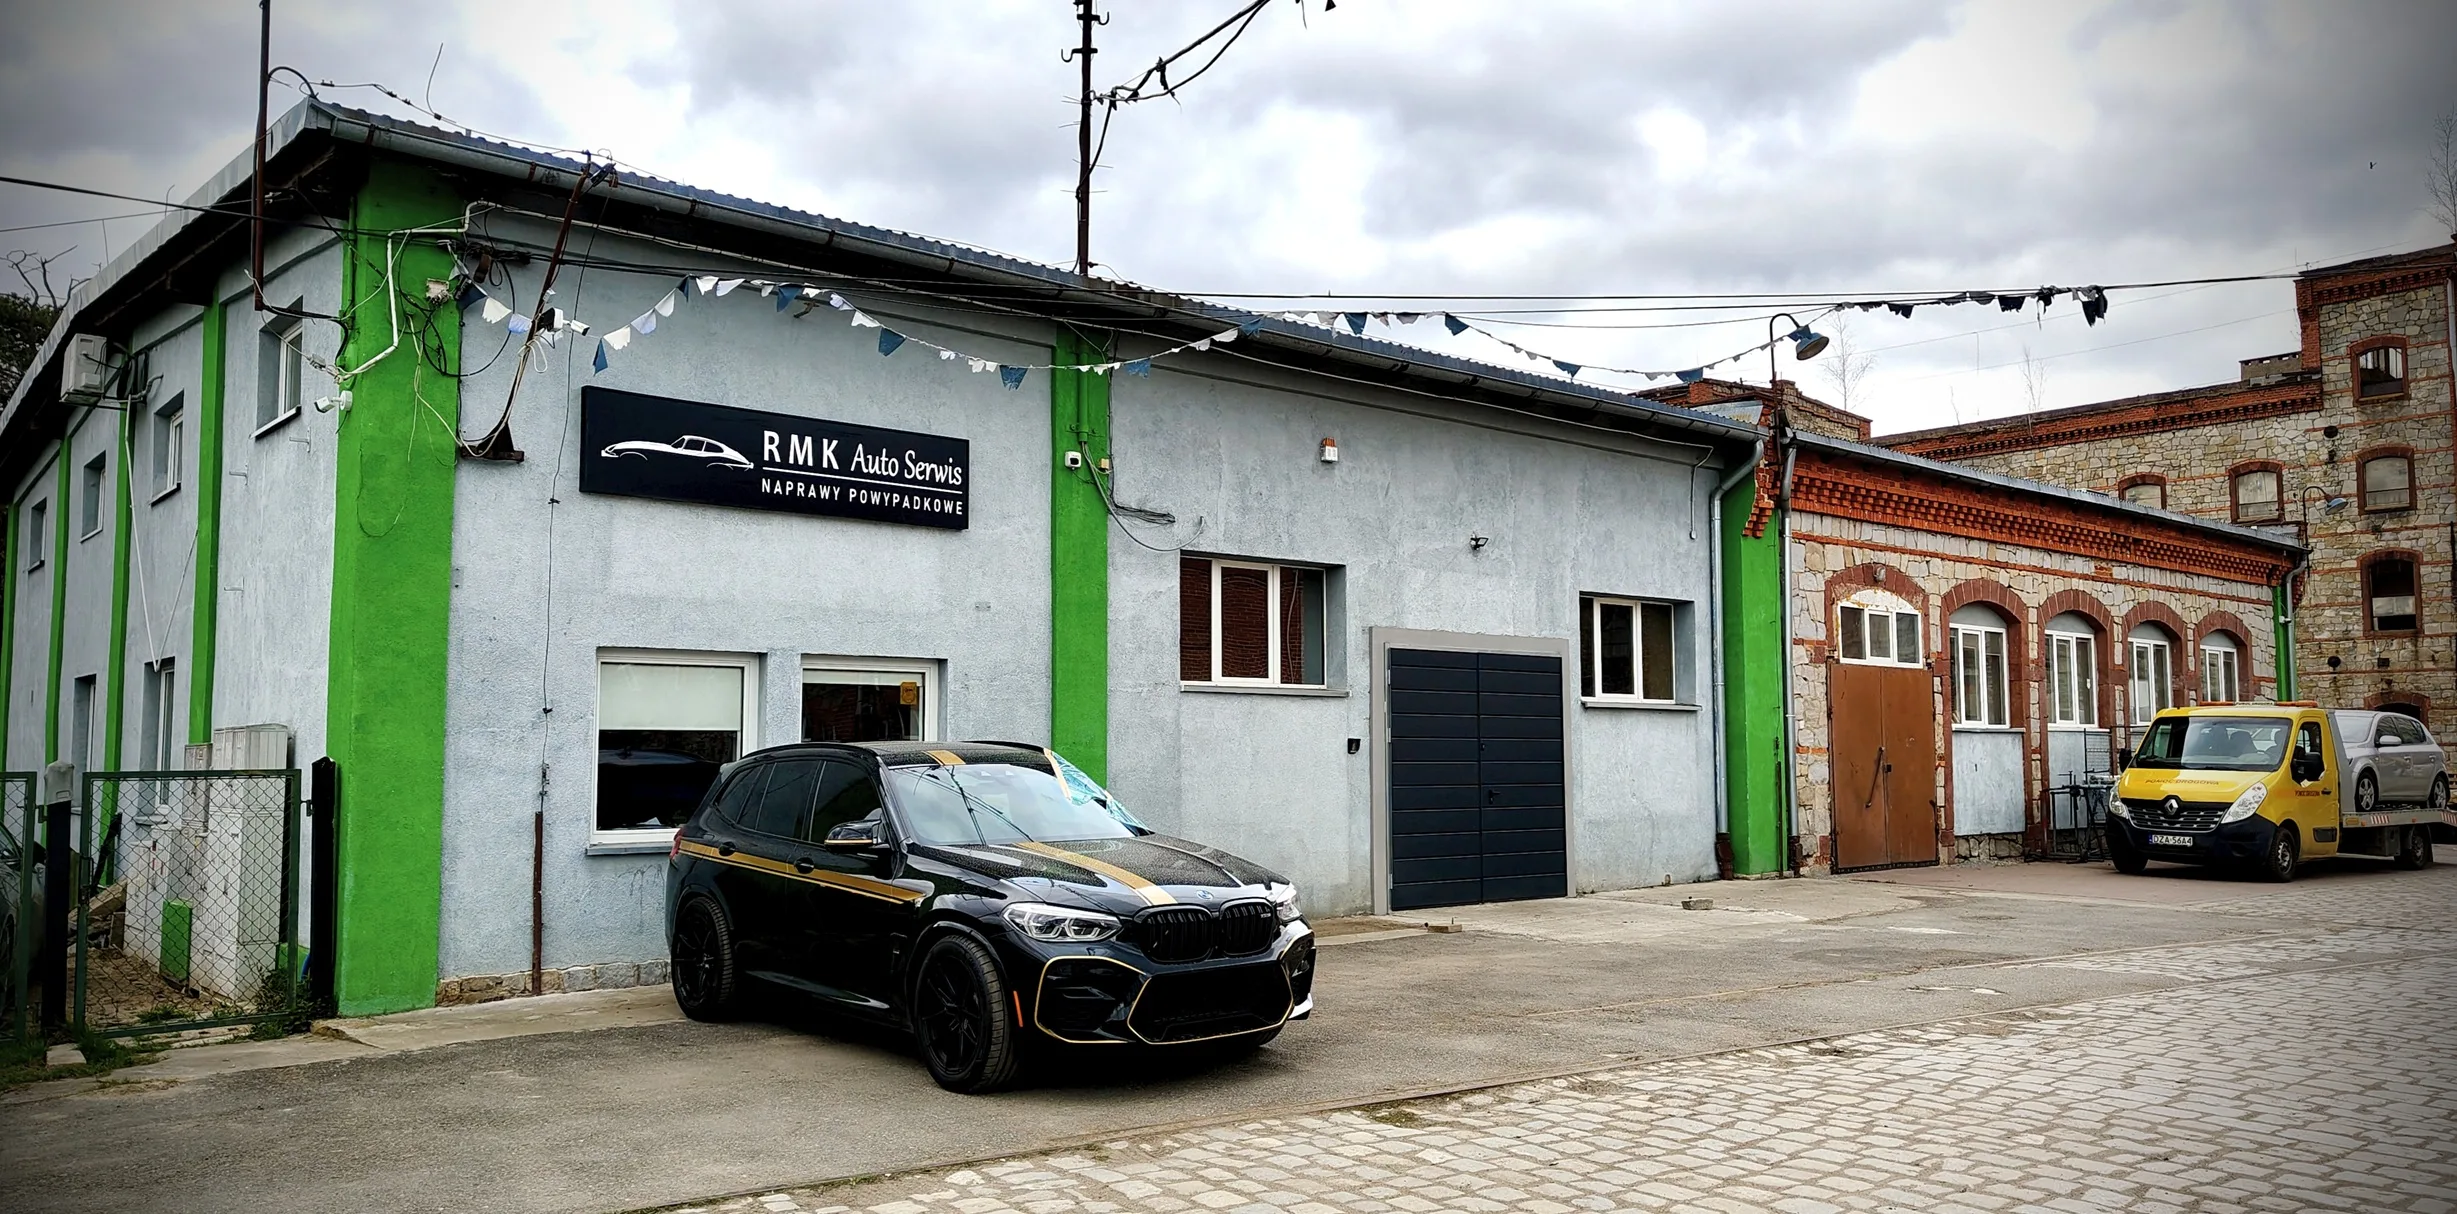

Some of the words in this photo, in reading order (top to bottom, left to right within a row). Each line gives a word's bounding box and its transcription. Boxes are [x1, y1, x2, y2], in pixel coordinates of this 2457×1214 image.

[763, 430, 840, 470] RMK
[850, 443, 899, 477] Auto
[904, 449, 963, 486] Serwis
[761, 477, 841, 501] NAPRAWY
[849, 488, 963, 515] POWYPADKOWE
[2153, 835, 2170, 844] DZA
